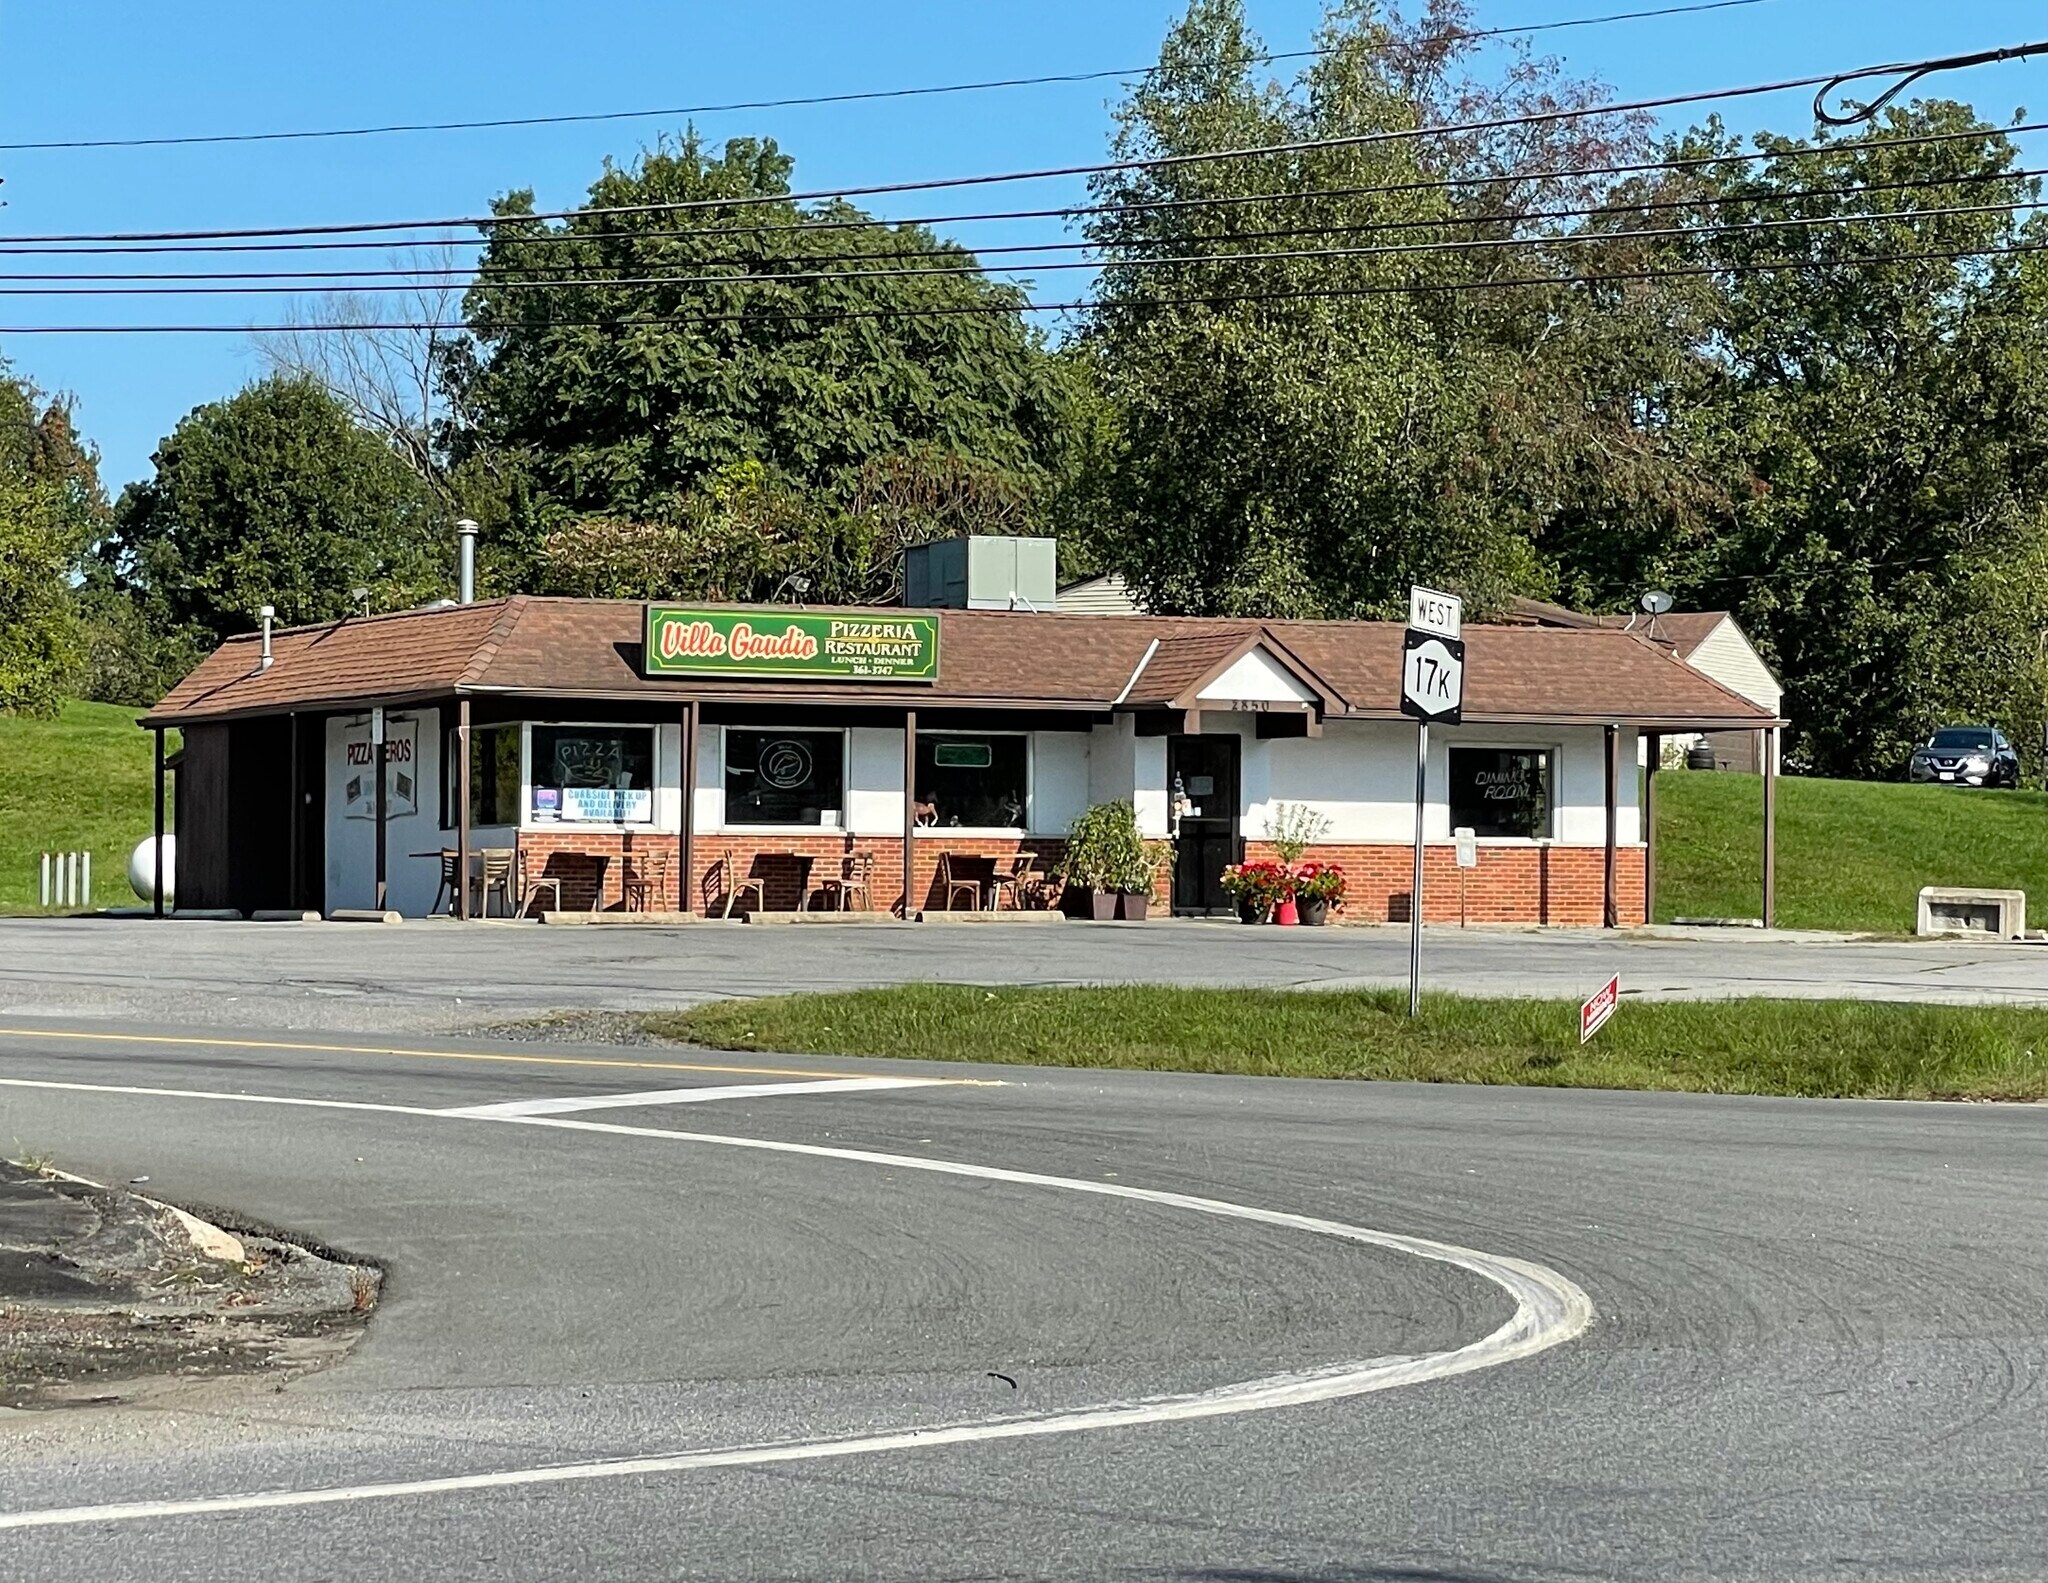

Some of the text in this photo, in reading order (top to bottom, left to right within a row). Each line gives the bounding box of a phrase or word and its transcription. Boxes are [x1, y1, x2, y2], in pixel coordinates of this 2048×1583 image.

[1418, 598, 1452, 627] WEST
[830, 621, 917, 640] PIZZERIA
[662, 622, 818, 660] Villa Gaudio
[825, 641, 922, 656] RESTAURANT
[831, 656, 915, 666] LUNCH DINNER
[1416, 656, 1451, 699] 17K
[1231, 700, 1270, 712] 2850
[347, 742, 374, 766] PIZZA
[561, 742, 620, 760] PIZZA
[1475, 769, 1526, 785] DINING
[568, 790, 611, 800] CURBSIDE
[636, 792, 647, 800] UP
[1484, 784, 1531, 799] ROOM
[577, 800, 596, 809] AND
